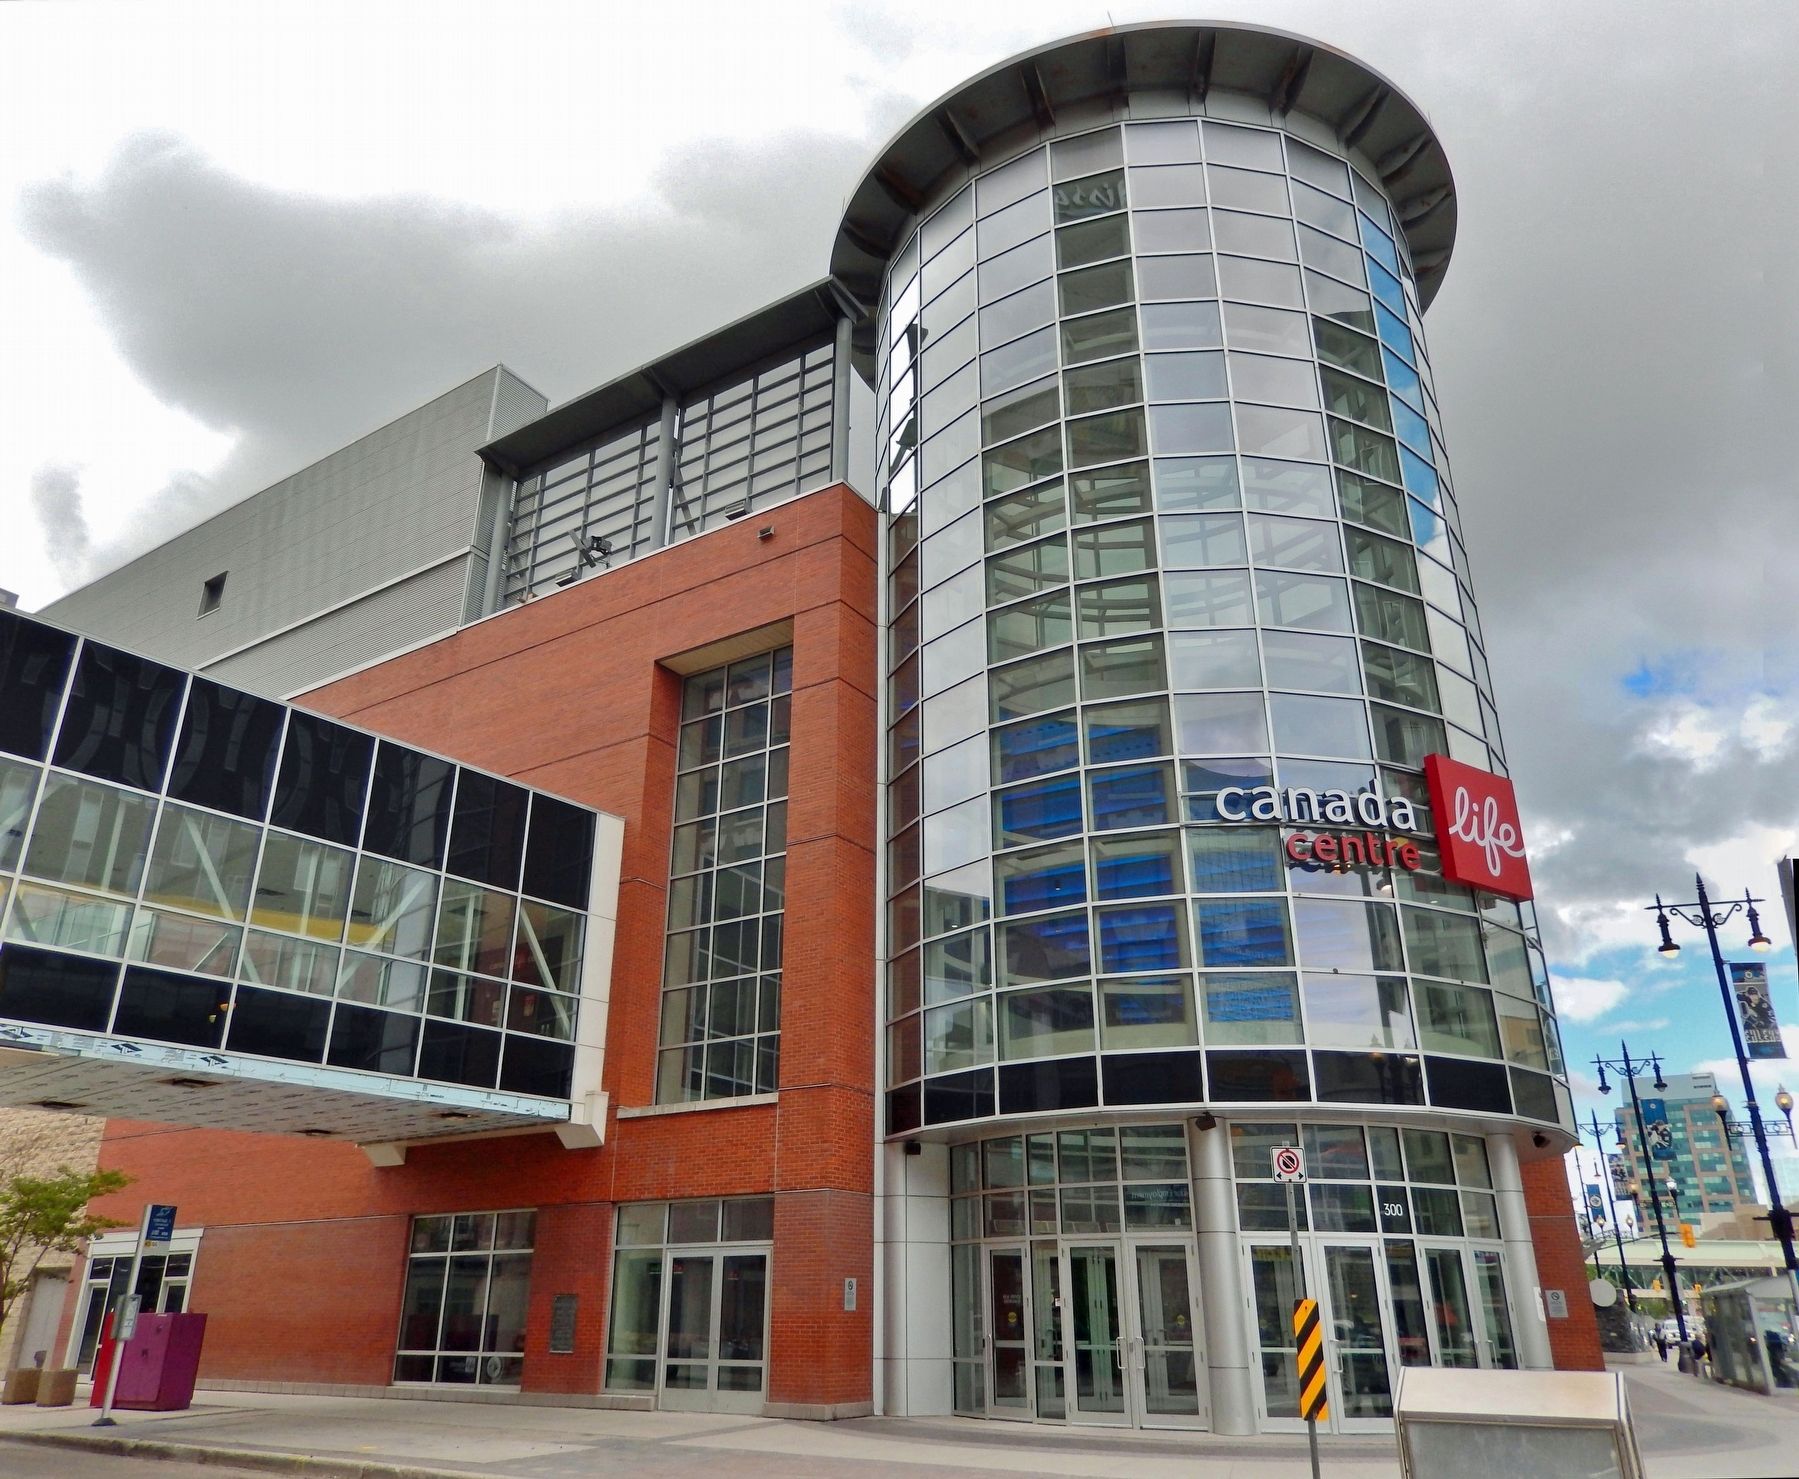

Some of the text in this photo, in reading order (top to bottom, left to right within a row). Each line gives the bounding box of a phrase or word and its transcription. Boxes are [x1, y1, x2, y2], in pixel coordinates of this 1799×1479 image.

[1216, 778, 1418, 832] canada
[1286, 832, 1421, 871] centre
[1449, 786, 1527, 877] life
[1383, 1203, 1403, 1216] 300
